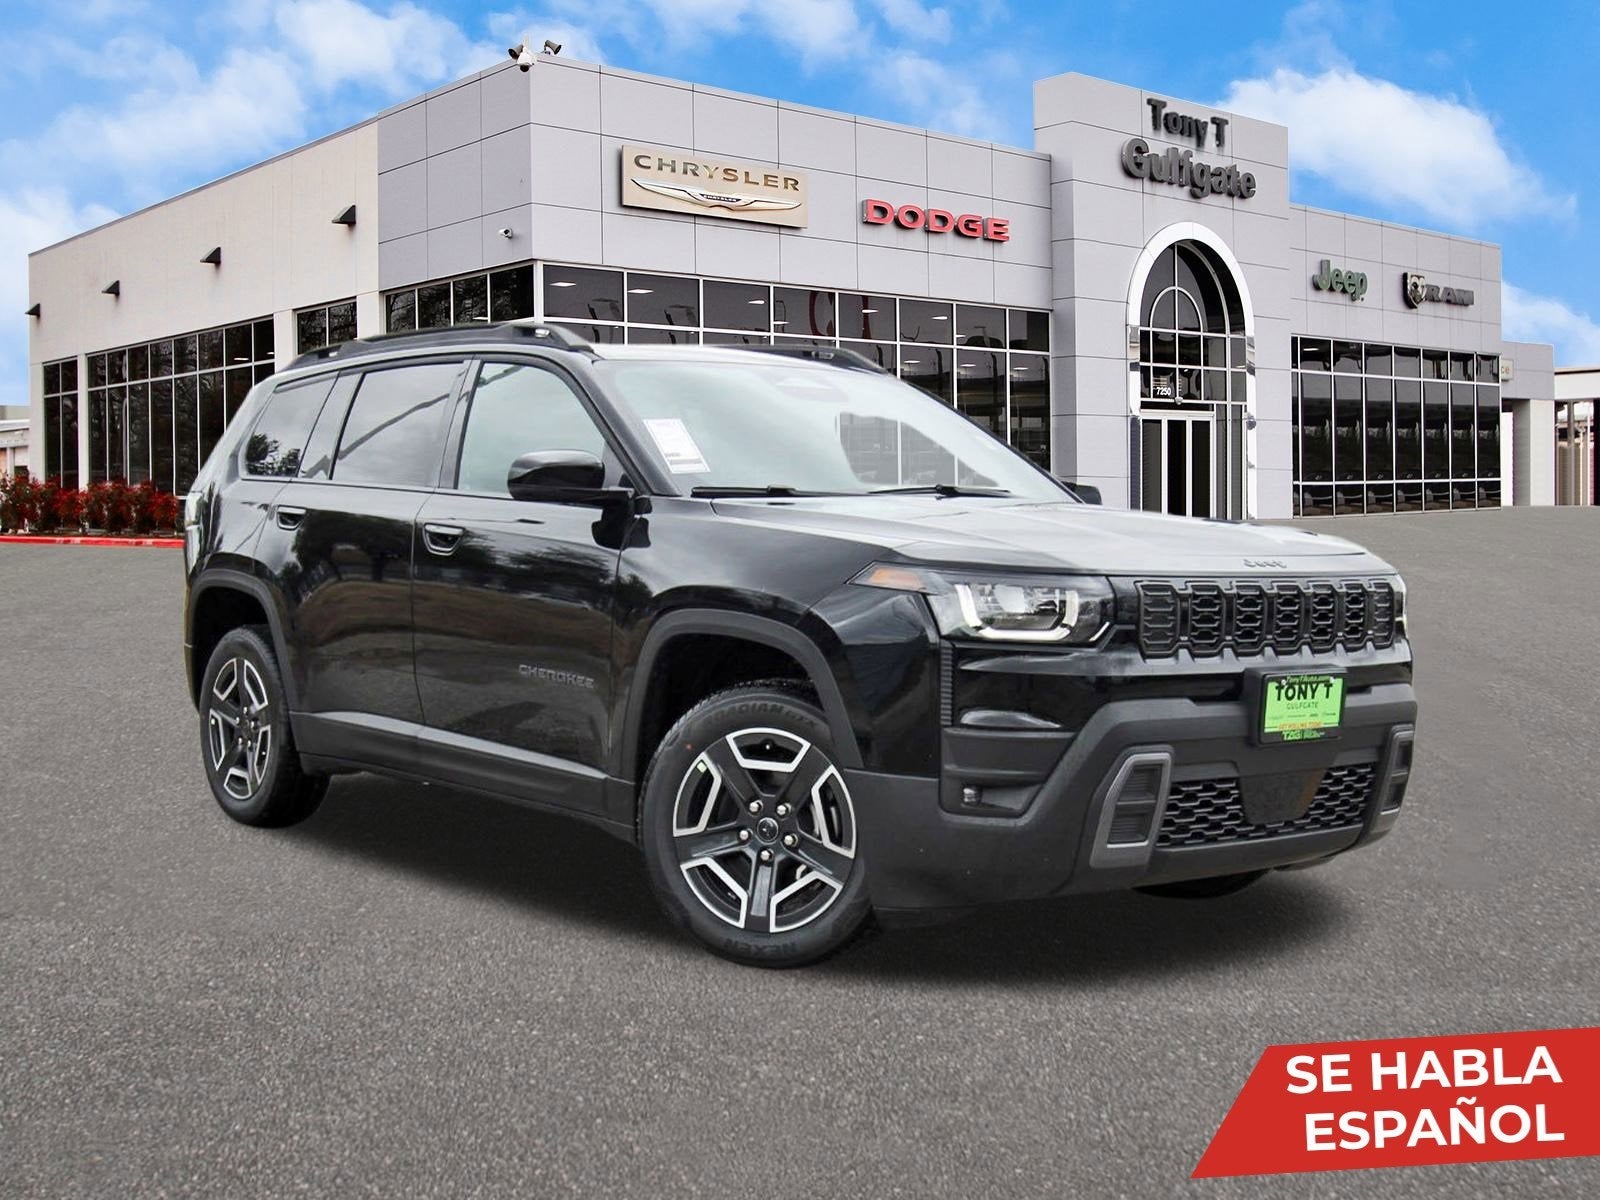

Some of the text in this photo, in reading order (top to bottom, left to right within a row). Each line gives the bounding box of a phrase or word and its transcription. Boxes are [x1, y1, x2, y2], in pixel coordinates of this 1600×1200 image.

[1146, 98, 1229, 148] Tony T
[633, 154, 800, 192] CHRYSLER
[1120, 138, 1256, 199] Gulfgate
[863, 199, 1010, 242] DODGE
[1312, 259, 1367, 302] Jeep
[1425, 284, 1474, 306] RAM
[1156, 387, 1172, 396] 7250
[519, 664, 594, 689] CHEROKEE
[1275, 682, 1333, 701] TONY T
